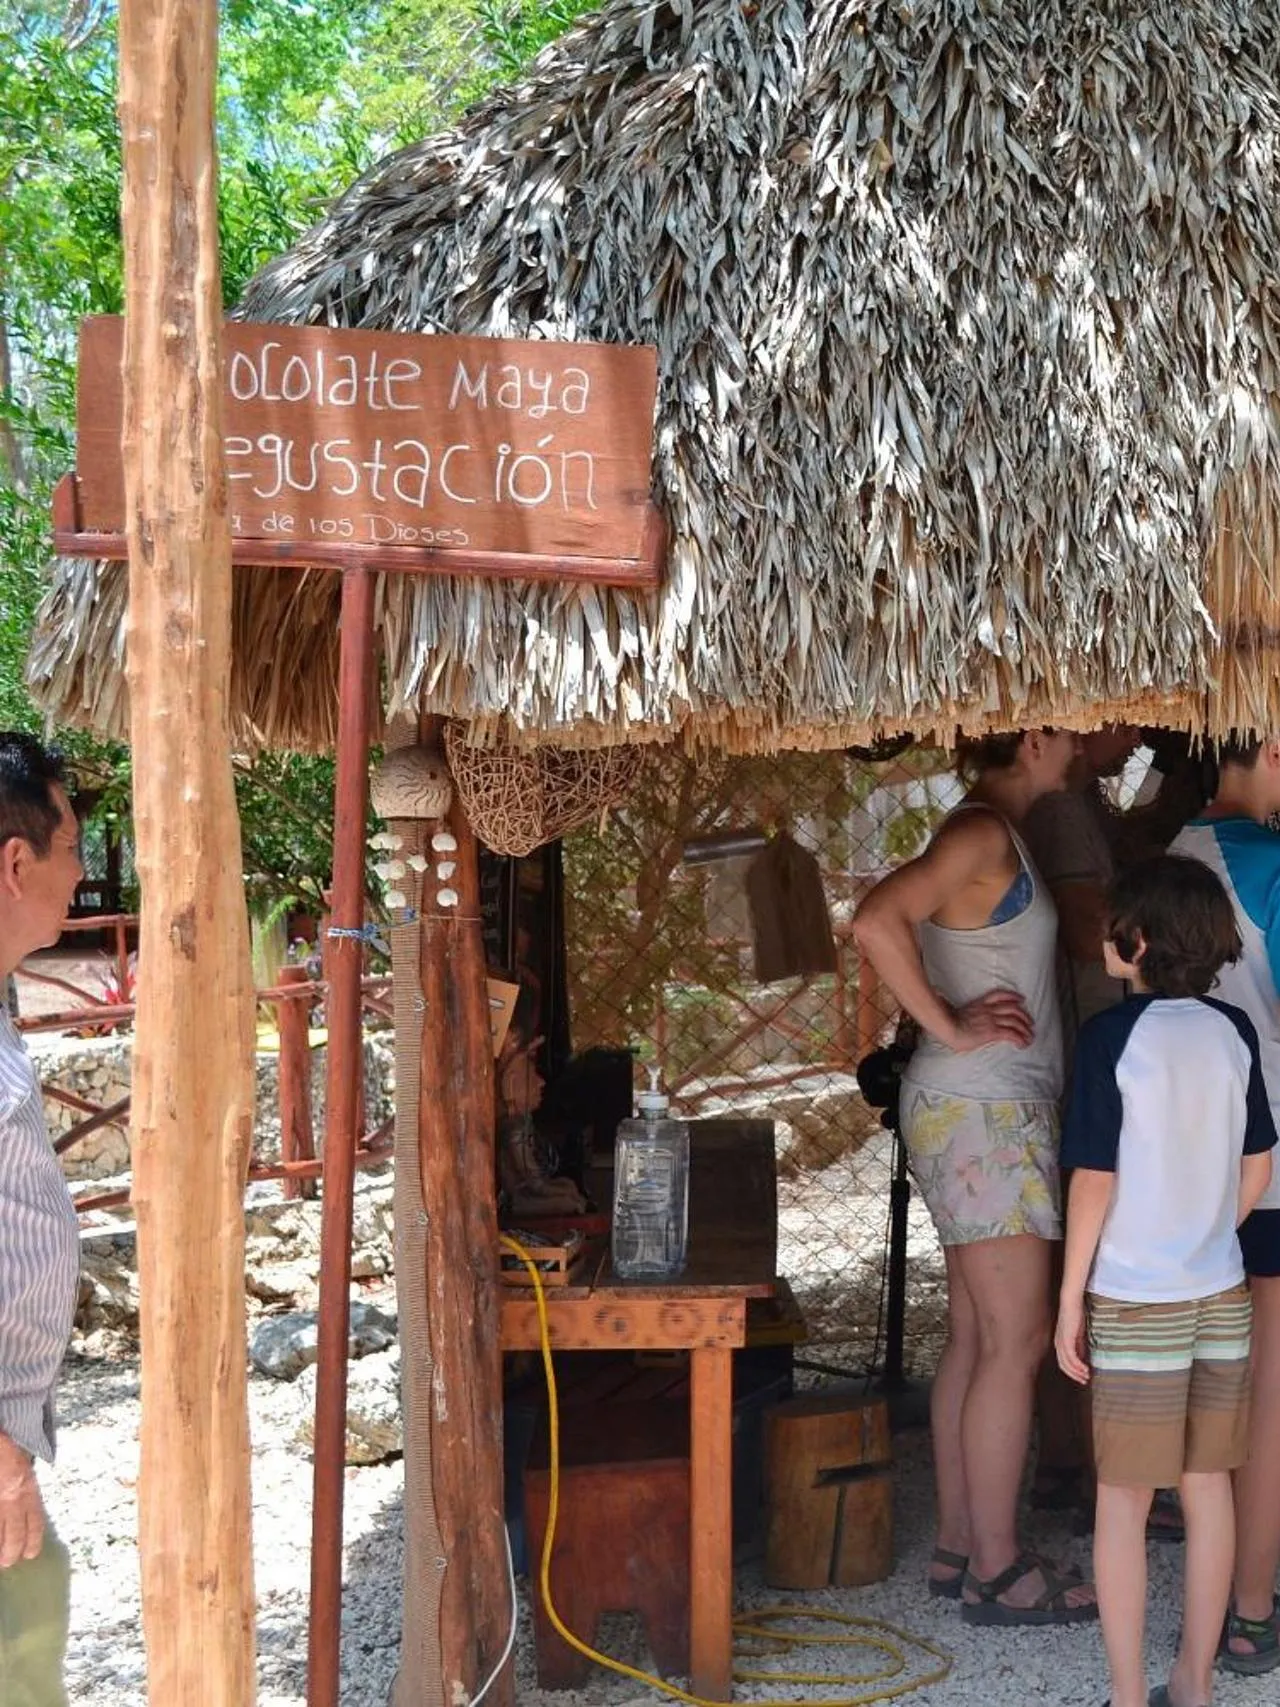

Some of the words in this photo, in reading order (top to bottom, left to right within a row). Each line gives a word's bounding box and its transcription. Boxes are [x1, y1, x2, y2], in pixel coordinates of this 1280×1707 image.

[230, 342, 422, 410] ocolate
[449, 360, 590, 419] Maya
[224, 433, 598, 512] egustación
[262, 510, 295, 534] de
[310, 517, 355, 538] los
[361, 512, 470, 546] Dioses
